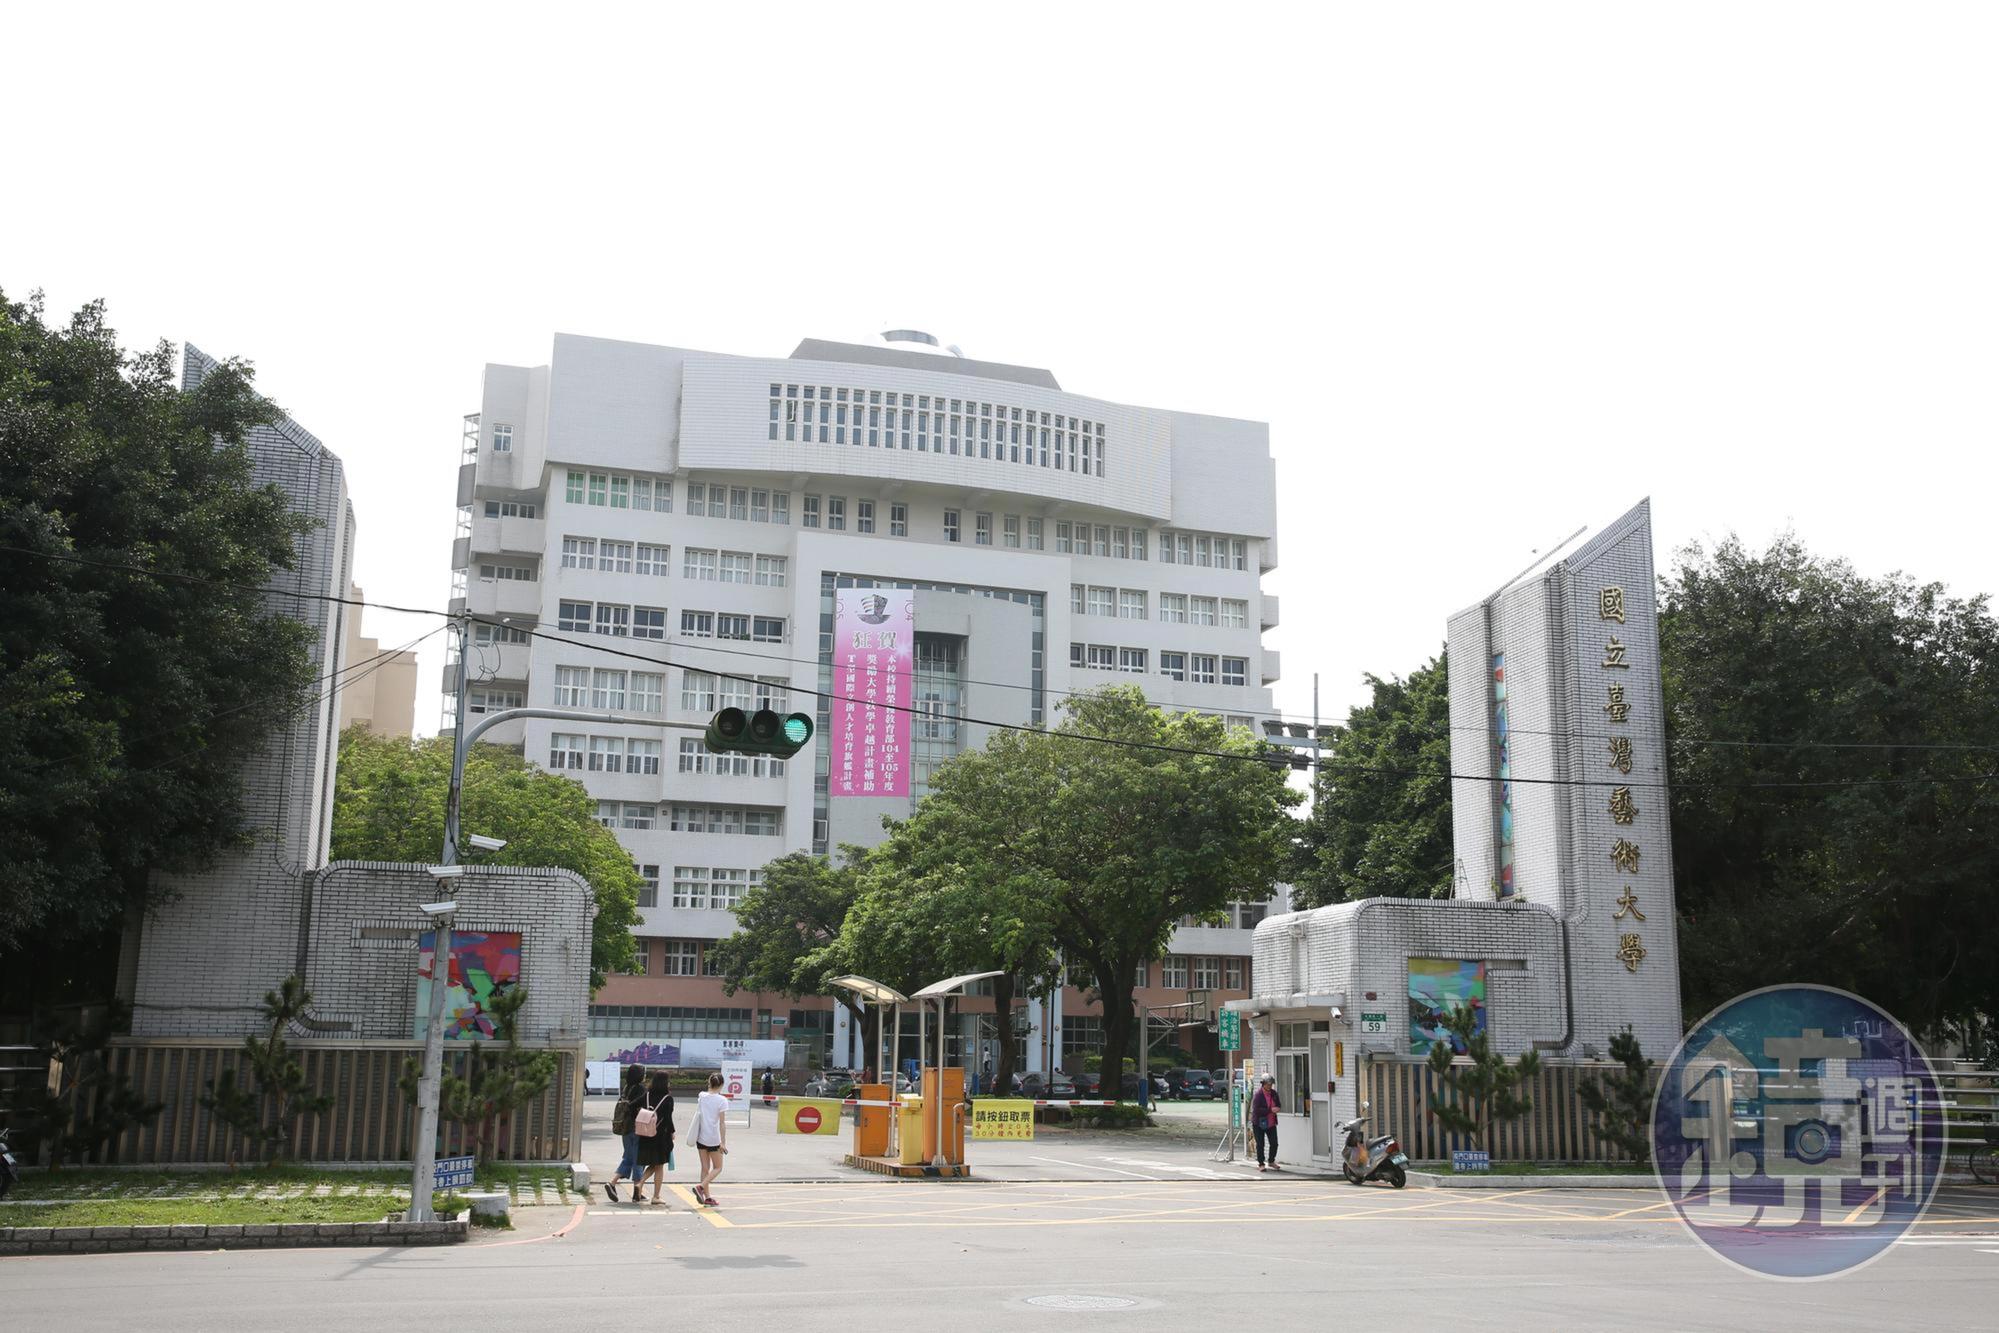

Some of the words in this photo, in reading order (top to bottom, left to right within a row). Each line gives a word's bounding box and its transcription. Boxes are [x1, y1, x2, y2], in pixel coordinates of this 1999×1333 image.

[854, 632, 897, 649] 狂賀
[1599, 586, 1647, 973] 國立臺灣藝術大學
[1368, 1022, 1381, 1031] 59
[976, 1111, 1031, 1122] 請按鈕取票
